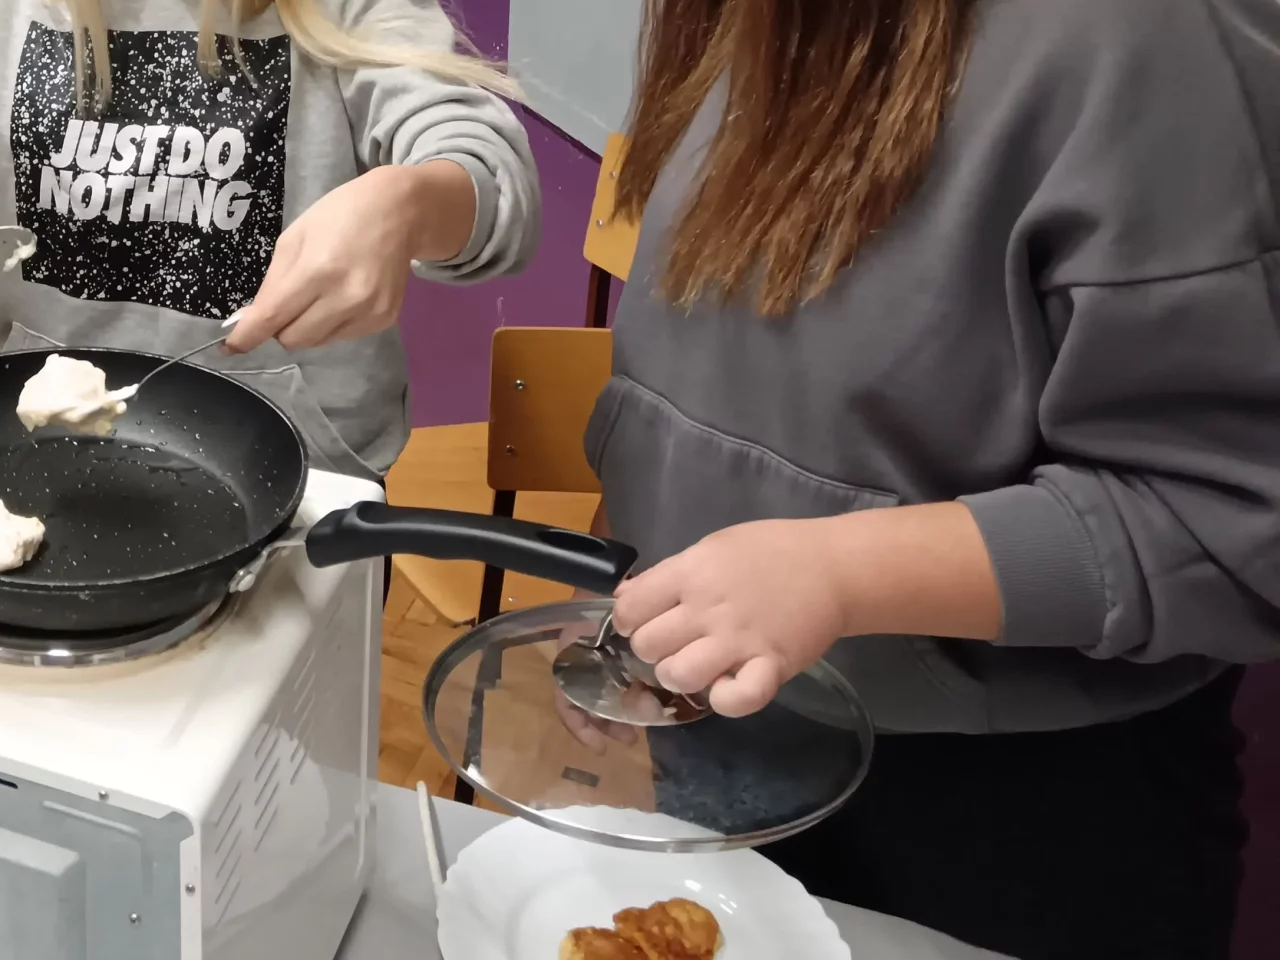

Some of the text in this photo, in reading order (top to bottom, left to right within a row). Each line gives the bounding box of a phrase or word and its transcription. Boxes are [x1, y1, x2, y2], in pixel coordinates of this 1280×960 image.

[50, 119, 246, 180] JUST DO
[37, 165, 257, 231] NOTHING
